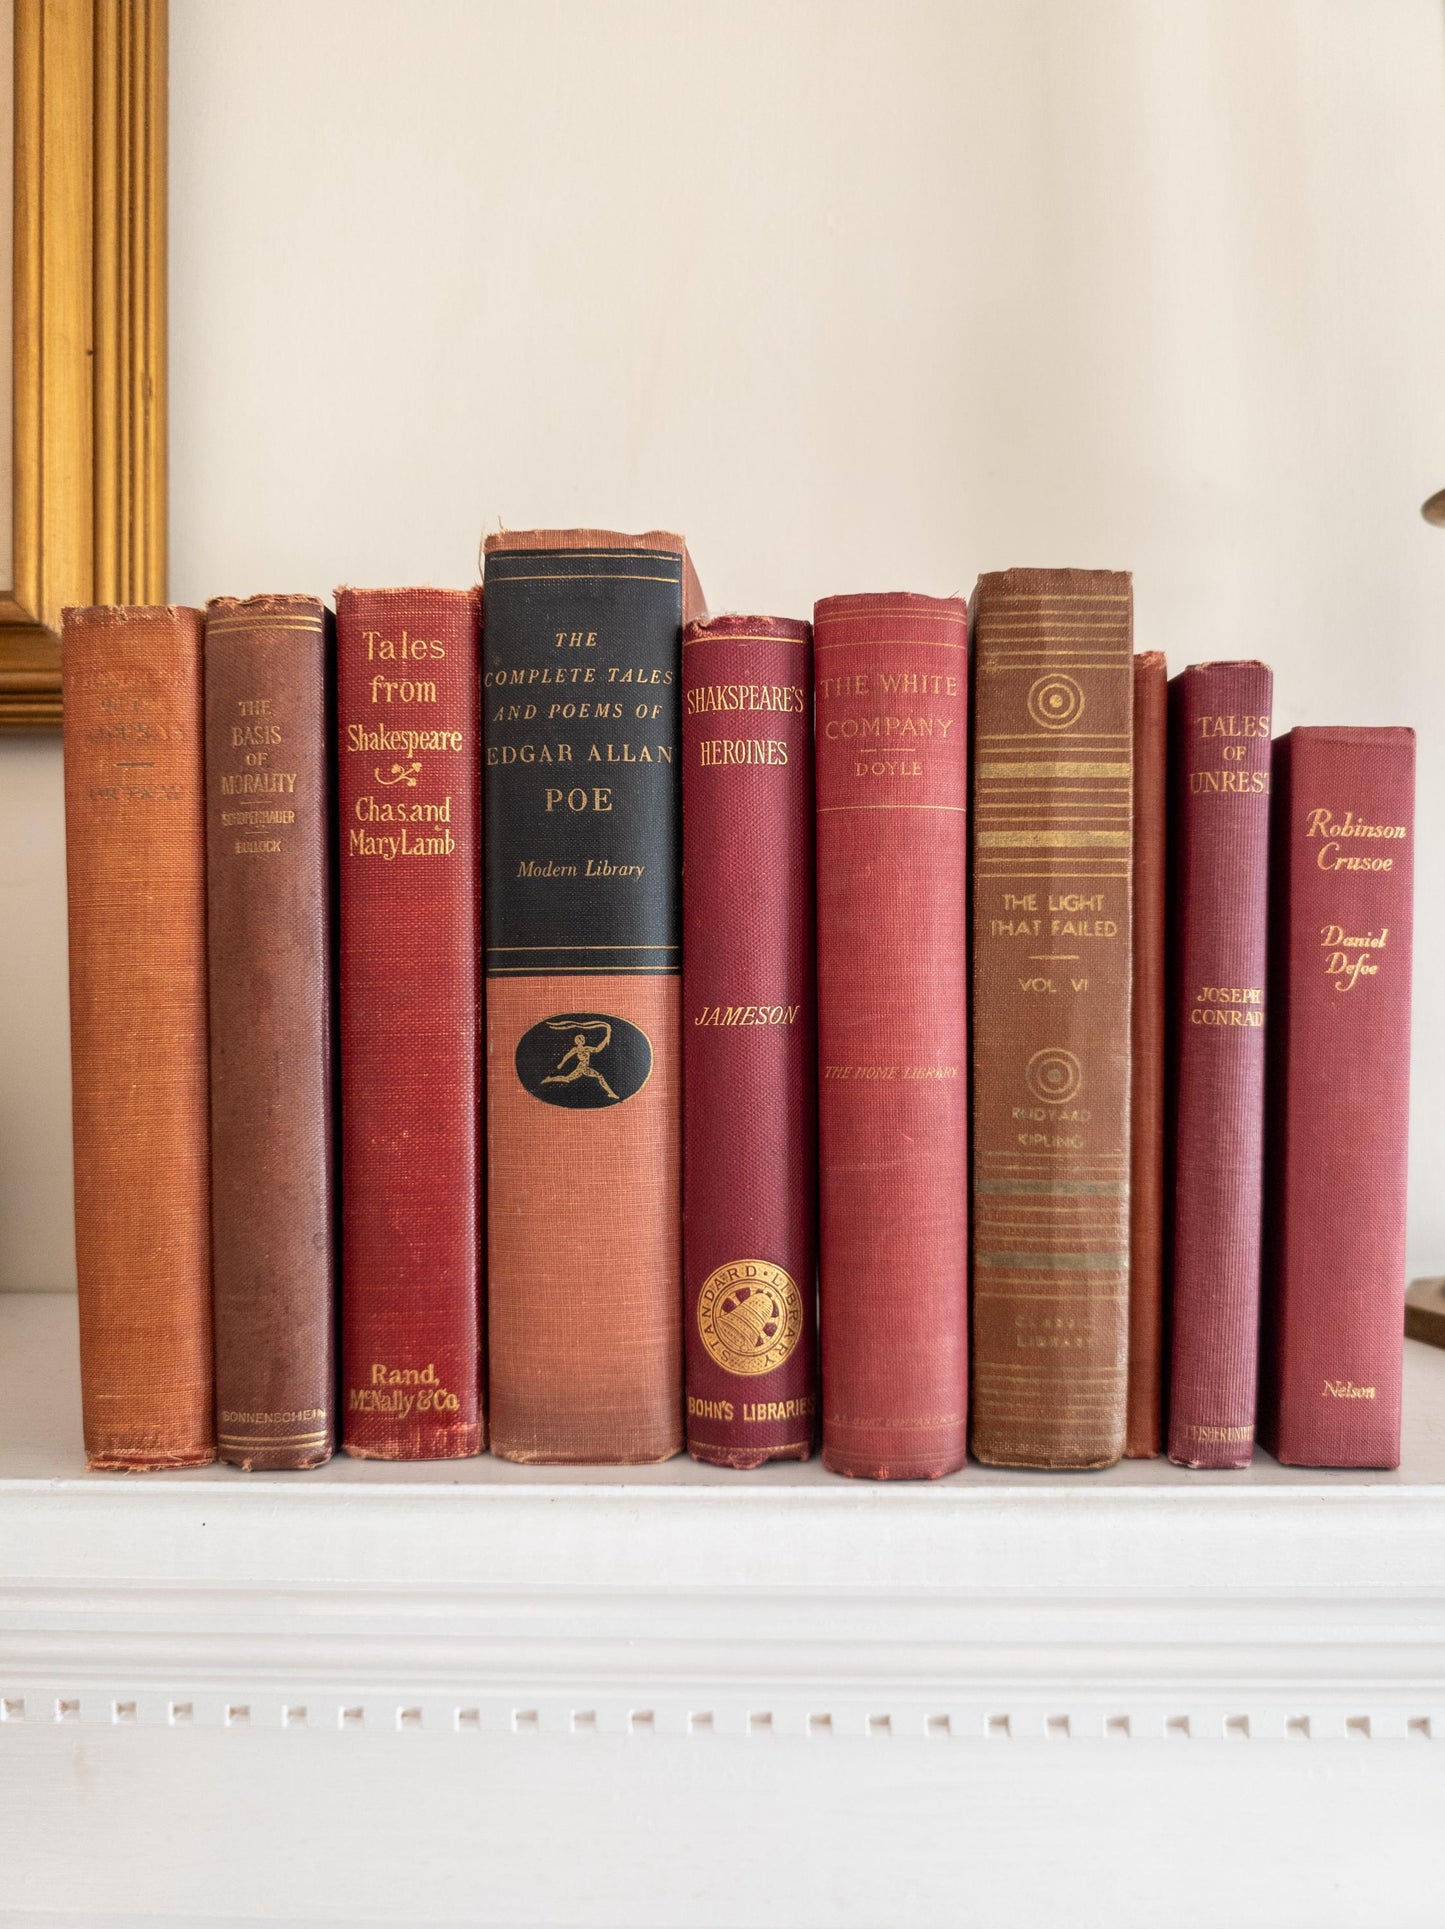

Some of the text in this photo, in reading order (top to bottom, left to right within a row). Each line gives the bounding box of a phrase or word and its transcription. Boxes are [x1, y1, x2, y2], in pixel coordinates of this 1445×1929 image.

[362, 631, 446, 660] Tales
[555, 632, 598, 648] THE
[484, 667, 674, 688] COMPLETE TALES
[820, 672, 958, 699] THE WHITE
[369, 675, 437, 704] from
[686, 684, 804, 715] SHAKSPEARE'S
[238, 700, 272, 716] THE
[493, 703, 663, 722] AND POEMS OF
[232, 725, 281, 749] BASIS
[825, 716, 954, 739] COMPANY
[1197, 715, 1271, 738] TALES
[347, 723, 463, 759] Shakespeare
[700, 739, 789, 766] HEROINES
[246, 752, 268, 766] OF
[487, 743, 673, 766] EDGAR ALLAN
[1223, 746, 1247, 761] OF
[854, 761, 924, 777] DOYLE
[221, 772, 297, 795] MORALITY
[355, 796, 452, 823] Chas. and
[544, 787, 614, 812] POE
[1306, 808, 1407, 839] Robinson
[349, 828, 456, 860] Mary Lamb
[1317, 842, 1393, 872] Crusoe
[516, 859, 646, 881] Modern Library
[1002, 894, 1104, 912] THE LIGHT
[990, 920, 1119, 937] THAT FAILED
[1320, 925, 1389, 949] Daniel
[1325, 952, 1379, 992] Defoe
[1018, 978, 1088, 992] VOL VI
[1196, 987, 1262, 1004] JOSEPH
[694, 1006, 800, 1026] JAMESON
[1191, 1009, 1264, 1027] CONRAD
[824, 1066, 959, 1080] THE HOME LIBRARY
[701, 1264, 799, 1367] STANDARD LIBRARY
[371, 1363, 440, 1386] Rand,
[416, 1389, 434, 1411] &
[1322, 1379, 1376, 1399] Nelson
[222, 1408, 327, 1424] SONNENSCHEIN
[688, 1396, 735, 1421] BOHN'S
